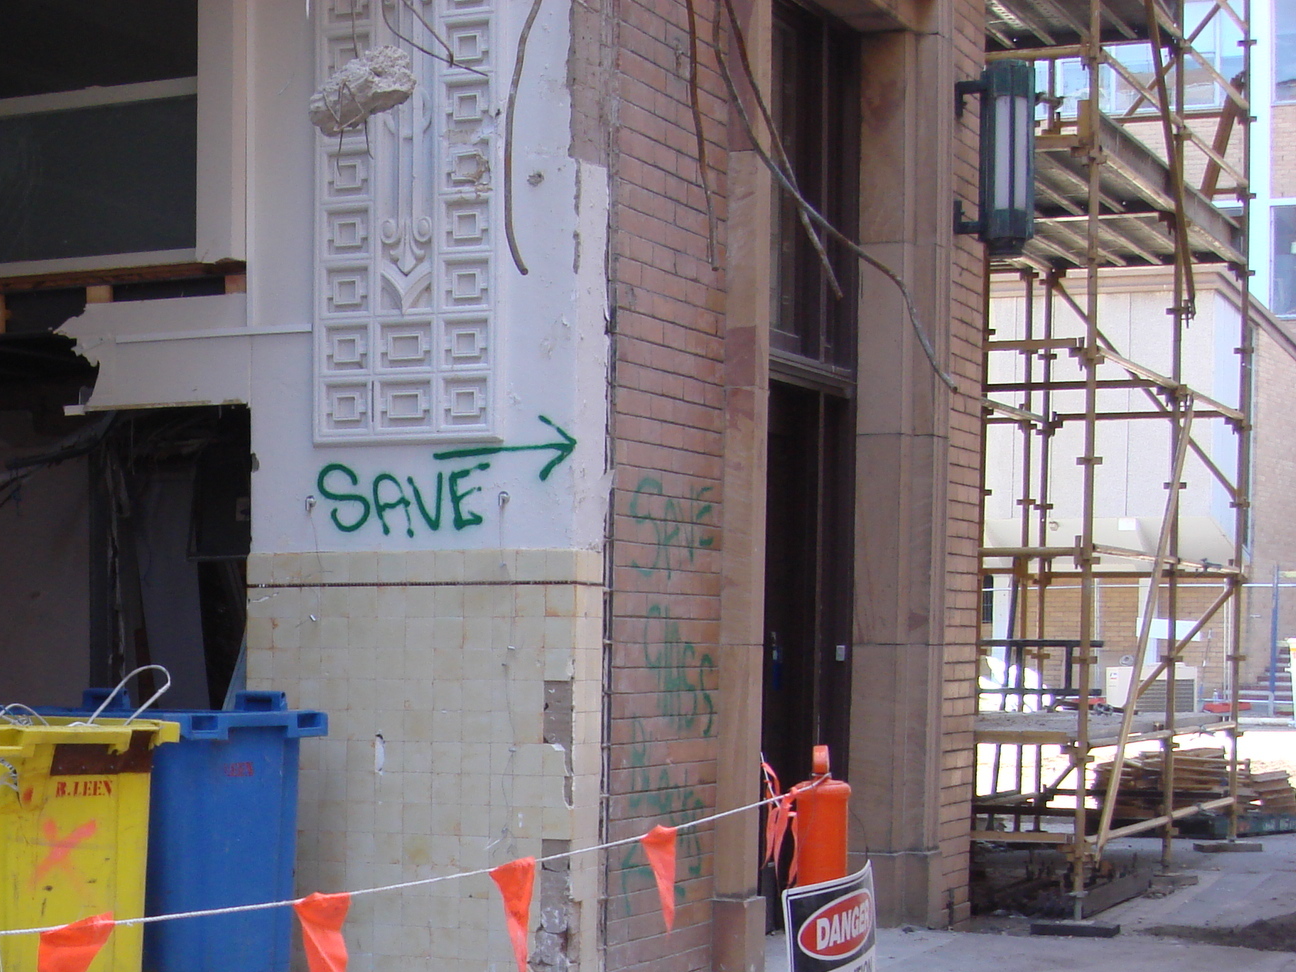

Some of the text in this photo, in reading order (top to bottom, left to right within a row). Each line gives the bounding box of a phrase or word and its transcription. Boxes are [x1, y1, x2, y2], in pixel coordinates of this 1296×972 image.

[316, 462, 491, 538] SAVE
[630, 477, 713, 579] SAVE
[816, 899, 870, 951] DANGER
